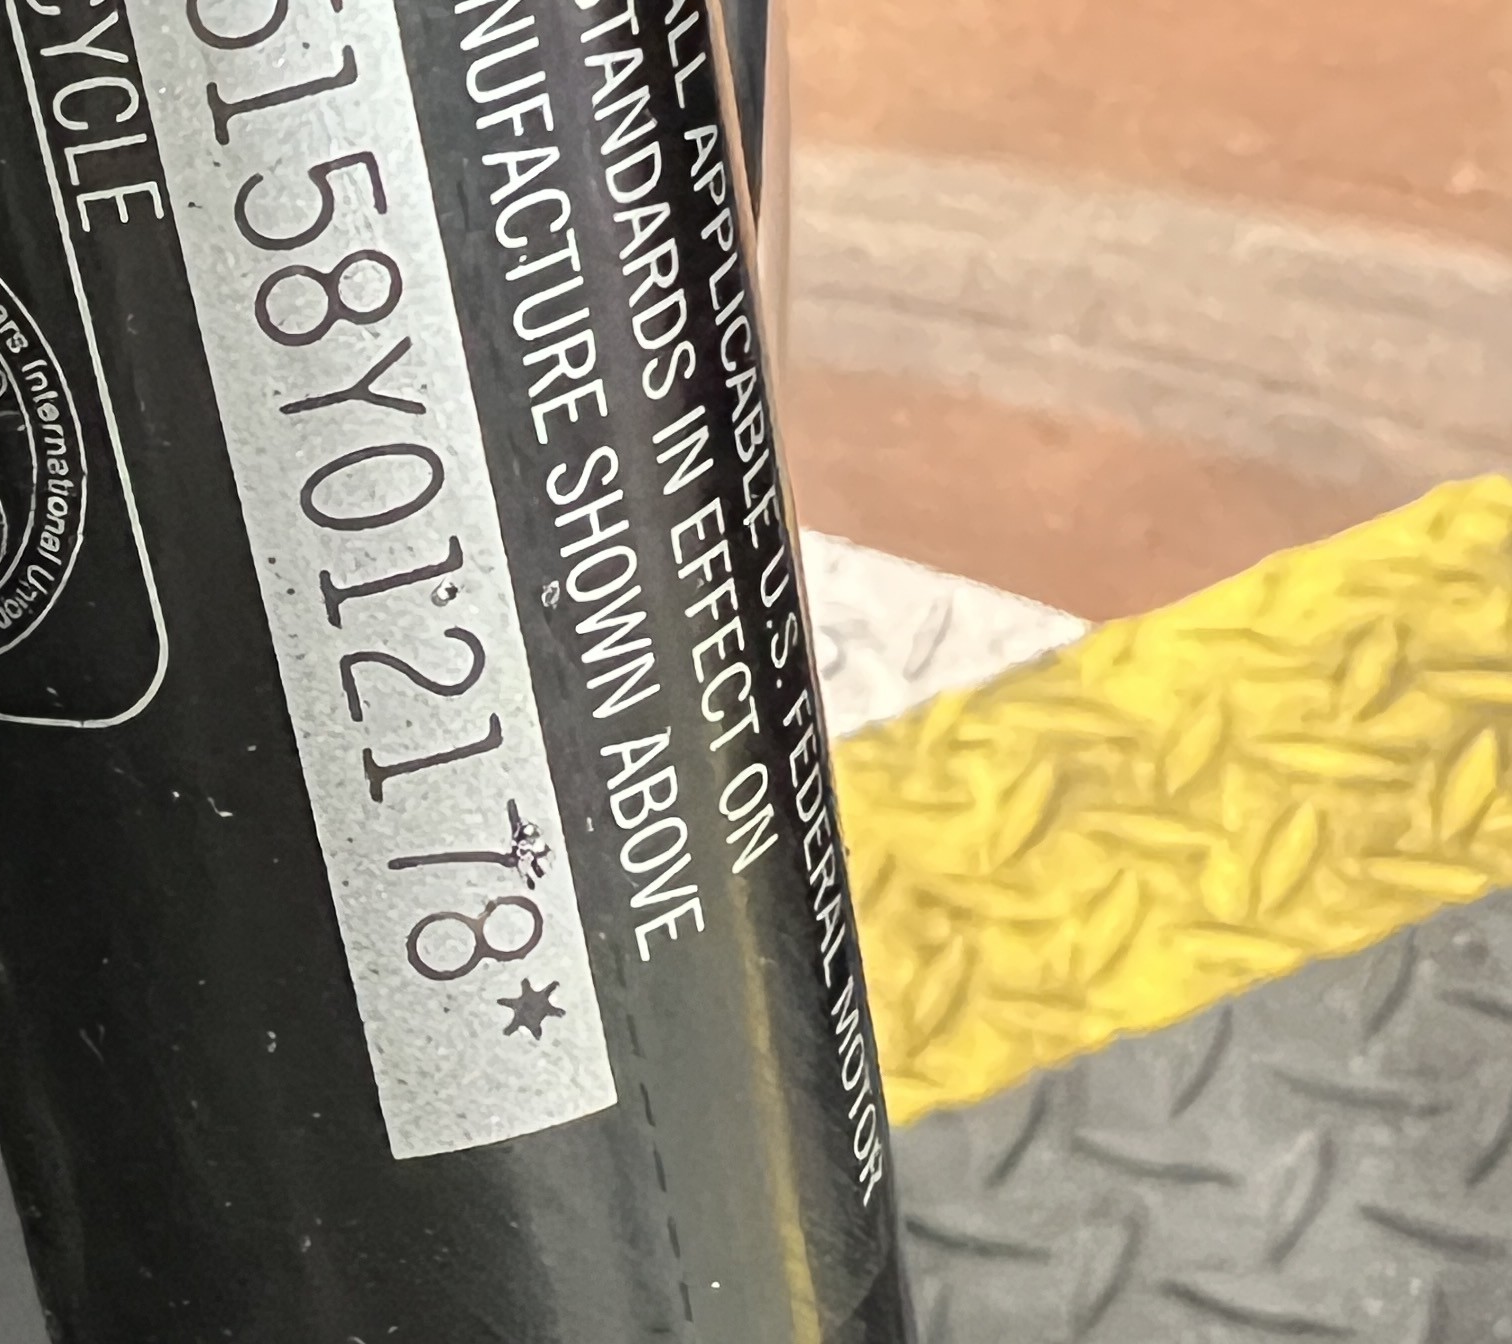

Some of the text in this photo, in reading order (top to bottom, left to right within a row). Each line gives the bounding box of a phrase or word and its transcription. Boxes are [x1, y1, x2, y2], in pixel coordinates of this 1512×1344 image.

[21, 358, 76, 568] International
[653, 406, 715, 497] IN
[545, 444, 661, 720] SHOWN
[670, 502, 760, 755] EFFECT
[684, 123, 780, 548] APPLICABLE
[758, 551, 799, 692] U.S.
[783, 690, 847, 988] FEDERAL
[830, 976, 883, 1207] MOTOR
[600, 725, 706, 962] ABOVE
[717, 763, 779, 875] ON
